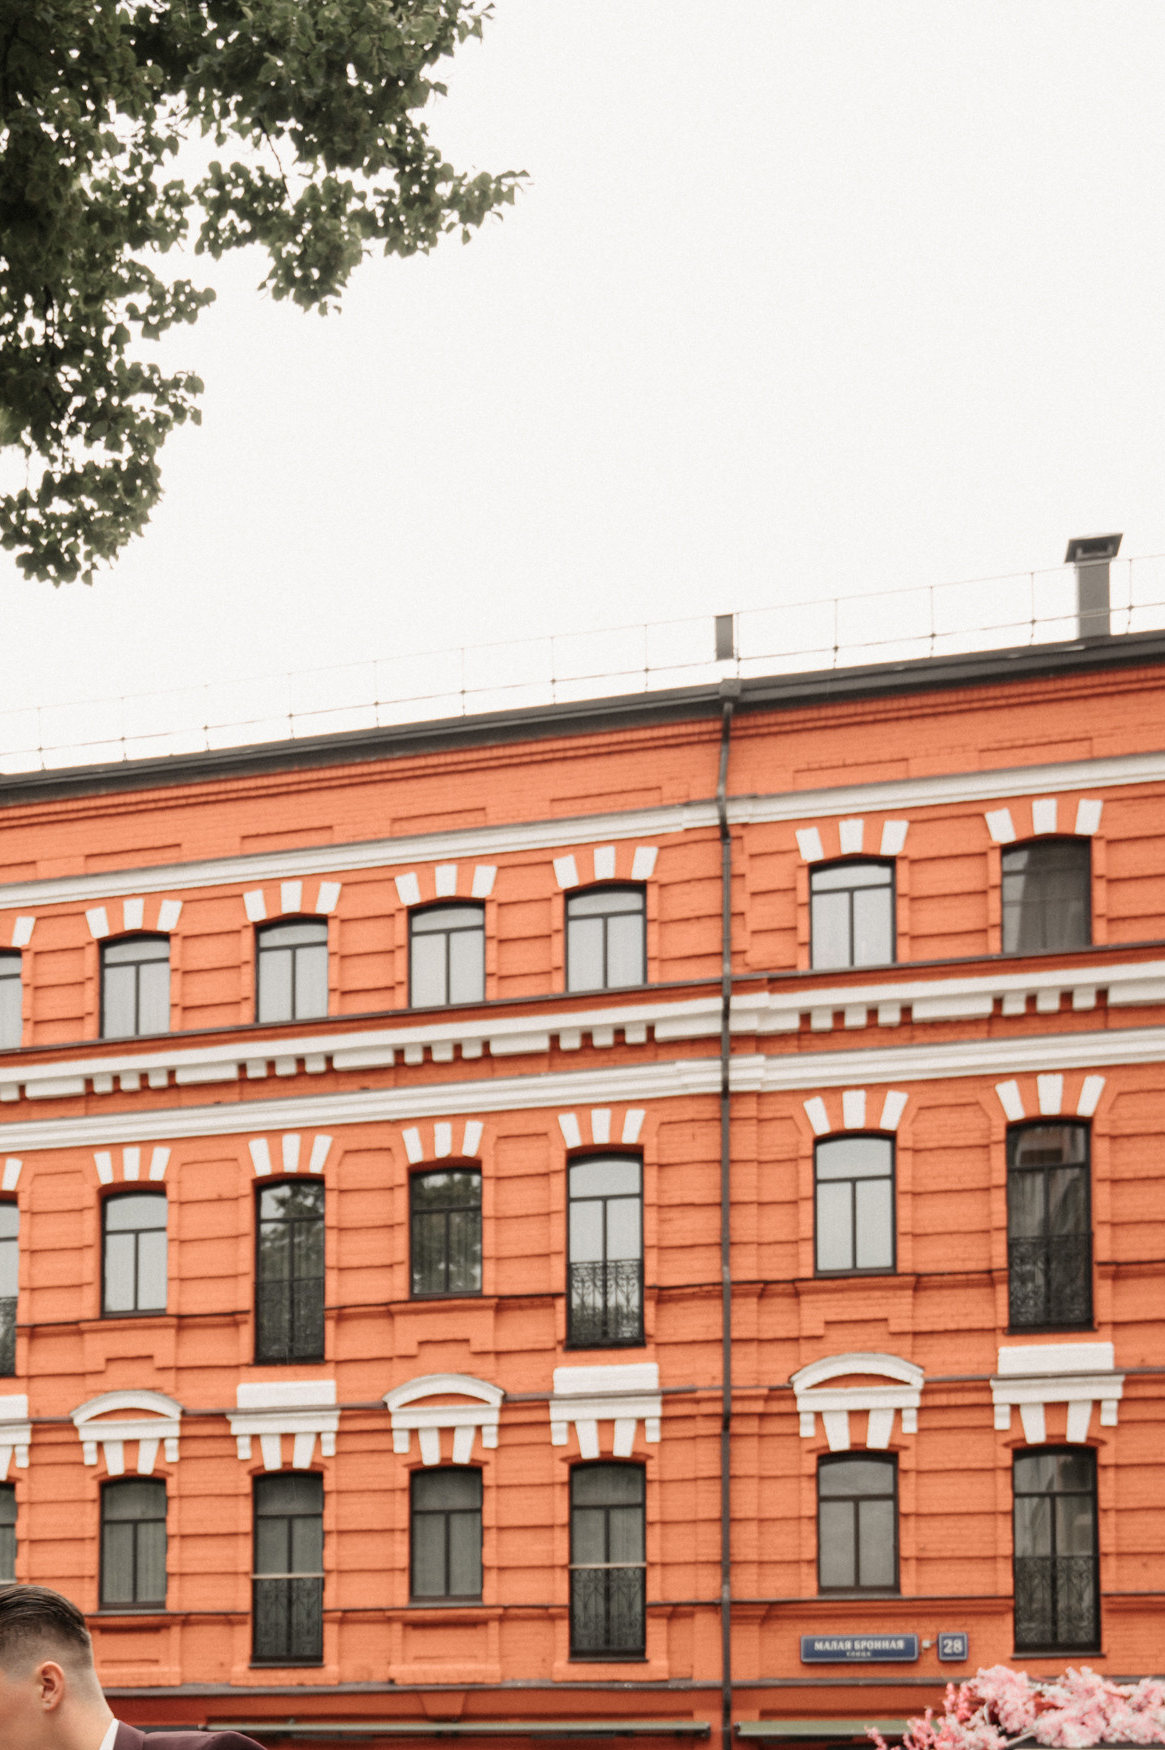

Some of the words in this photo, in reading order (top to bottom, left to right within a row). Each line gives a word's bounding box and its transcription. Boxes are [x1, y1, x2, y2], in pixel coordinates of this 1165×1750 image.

[814, 1640, 852, 1650] МАЛАЯ
[854, 1639, 904, 1650] БРОННАЯ
[943, 1639, 962, 1654] 28
